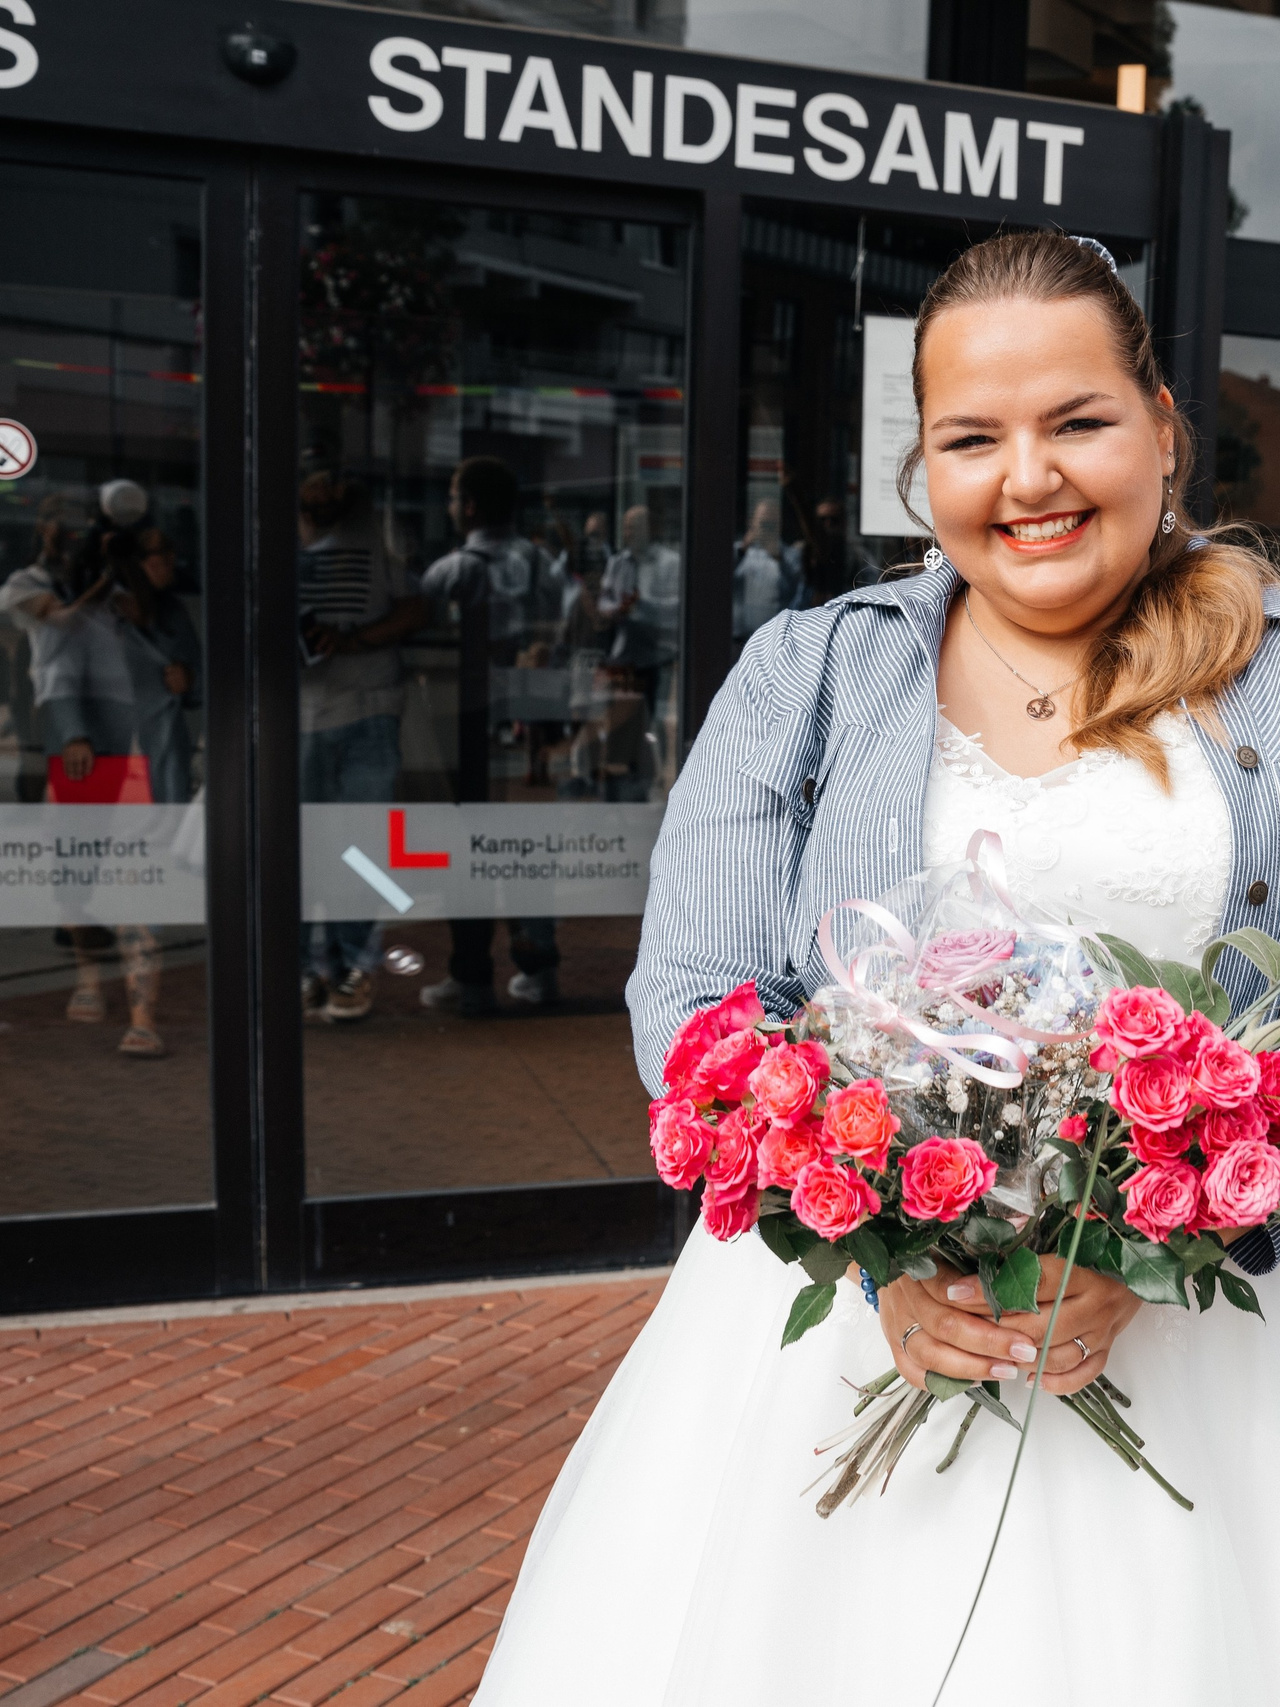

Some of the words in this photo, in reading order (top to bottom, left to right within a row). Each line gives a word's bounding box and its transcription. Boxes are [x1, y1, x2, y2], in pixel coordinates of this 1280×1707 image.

[368, 37, 1084, 206] STANDESAMT
[0, 836, 149, 863] mp-Lintfort
[470, 833, 626, 857] Kamp-Lintfort
[0, 865, 164, 886] chschulstadt
[470, 859, 640, 880] Hochschulstadt
